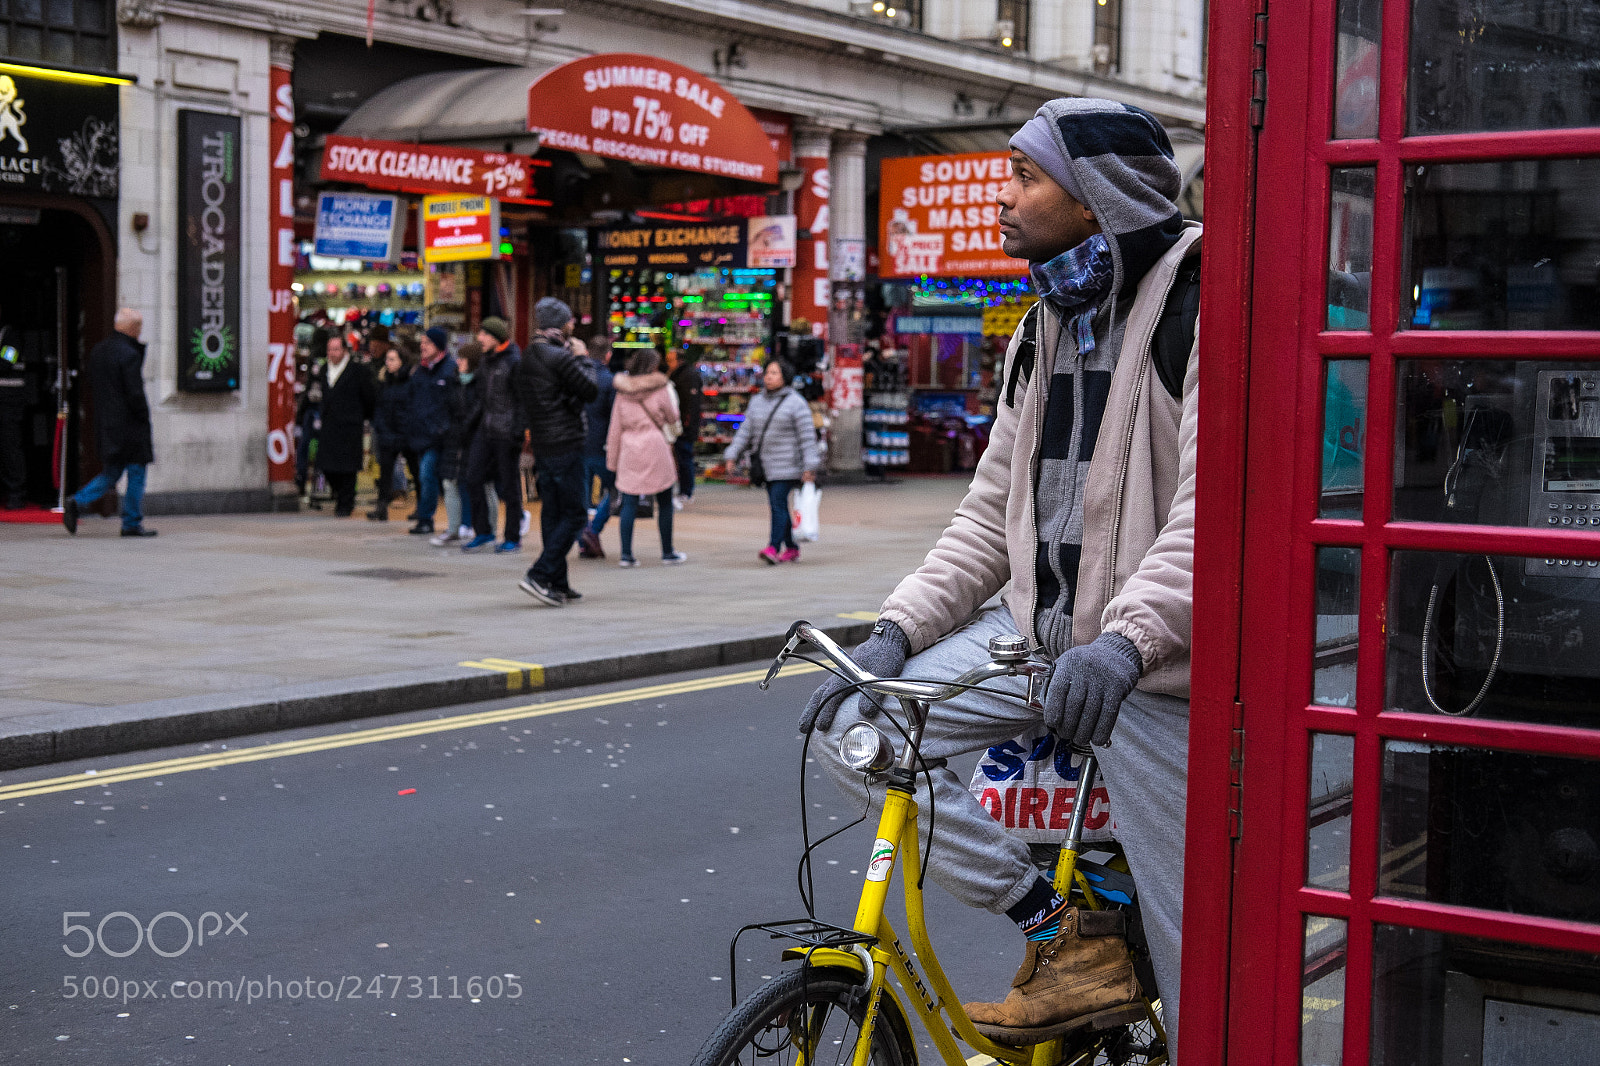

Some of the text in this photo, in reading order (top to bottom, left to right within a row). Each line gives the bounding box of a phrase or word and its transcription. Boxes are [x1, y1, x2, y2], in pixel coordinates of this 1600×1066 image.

[583, 66, 726, 118] SUMMER SALE
[591, 96, 710, 147] UP TO 75% OFF
[328, 145, 475, 185] STOCK CLEARANCE
[481, 159, 526, 194] 75%
[592, 137, 669, 164] DISCOUNT
[670, 150, 702, 168] FOR
[703, 155, 764, 179] STUDENT
[654, 225, 740, 247] EXCHANGE
[928, 206, 1004, 230] MASS
[202, 131, 226, 360] TROCADERO
[951, 228, 1007, 253] SAL
